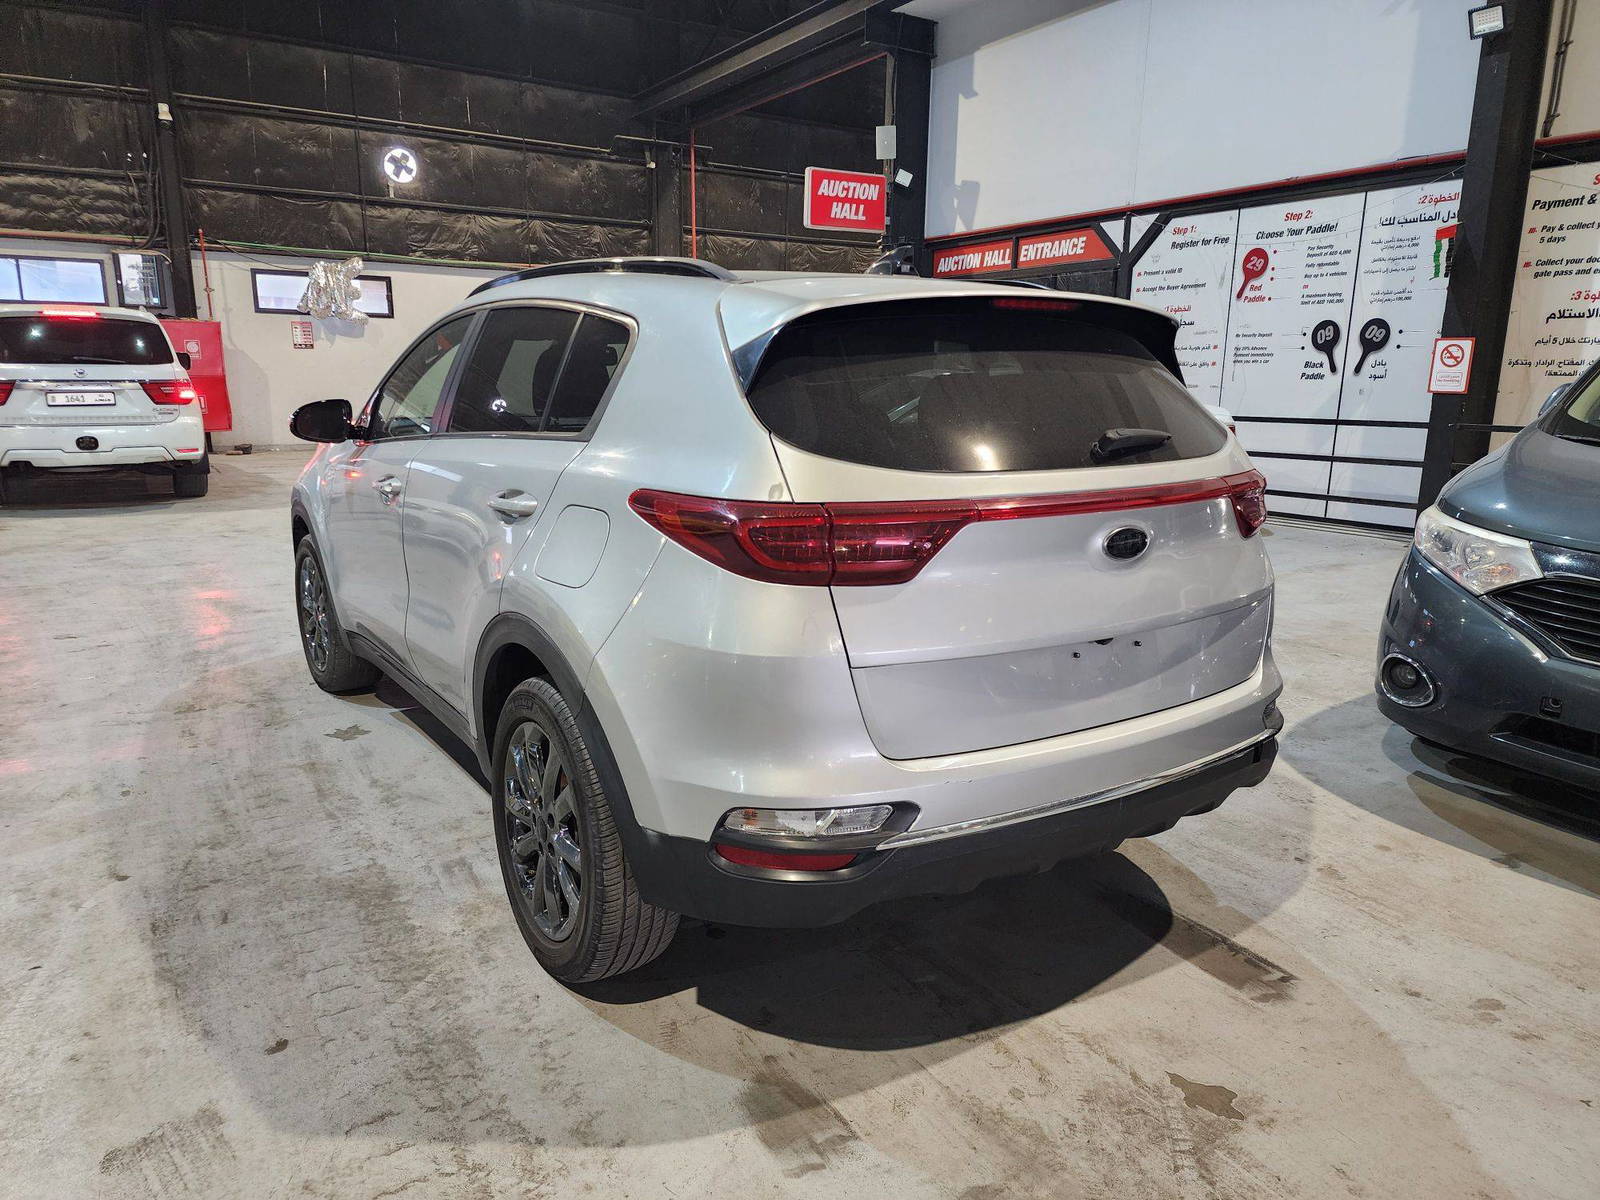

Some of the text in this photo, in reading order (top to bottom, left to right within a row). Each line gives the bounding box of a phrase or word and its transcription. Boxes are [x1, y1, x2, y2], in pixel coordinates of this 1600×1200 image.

[817, 179, 880, 201] AUCTION
[1428, 192, 1460, 206] الخطوة
[1531, 193, 1598, 211] Payment &
[830, 202, 866, 221] HALL
[1284, 210, 1314, 222] Step 2:
[1397, 210, 1441, 228] المناسب
[1172, 225, 1198, 236] Step 1:
[1256, 222, 1339, 240] Choose Your Paddle!
[1541, 225, 1556, 233] Pay
[1558, 224, 1566, 232] &
[1566, 220, 1596, 231] collect
[1171, 236, 1230, 251] Register for Free
[1539, 236, 1567, 244] 5 days
[937, 236, 1087, 273] AUCTION HALL ENTRANCE
[1246, 256, 1265, 272] 29
[1535, 258, 1563, 267] Collect
[1565, 258, 1584, 268] your
[1533, 270, 1552, 280] gate
[1553, 269, 1574, 278] pass
[1575, 267, 1592, 275] and
[1180, 282, 1207, 290] Agreement
[1249, 284, 1263, 292] Red
[1570, 290, 1582, 301] 3:
[1316, 325, 1335, 344] 09
[1365, 325, 1386, 343] 09
[1552, 336, 1558, 344] 5
[1535, 334, 1551, 347] أيام
[1558, 336, 1576, 345] خلال
[1303, 361, 1325, 369] Black
[1370, 359, 1387, 368] بادل
[1508, 359, 1532, 367] وتذكرة
[1368, 369, 1387, 381] أسود
[65, 395, 86, 403] 1641
